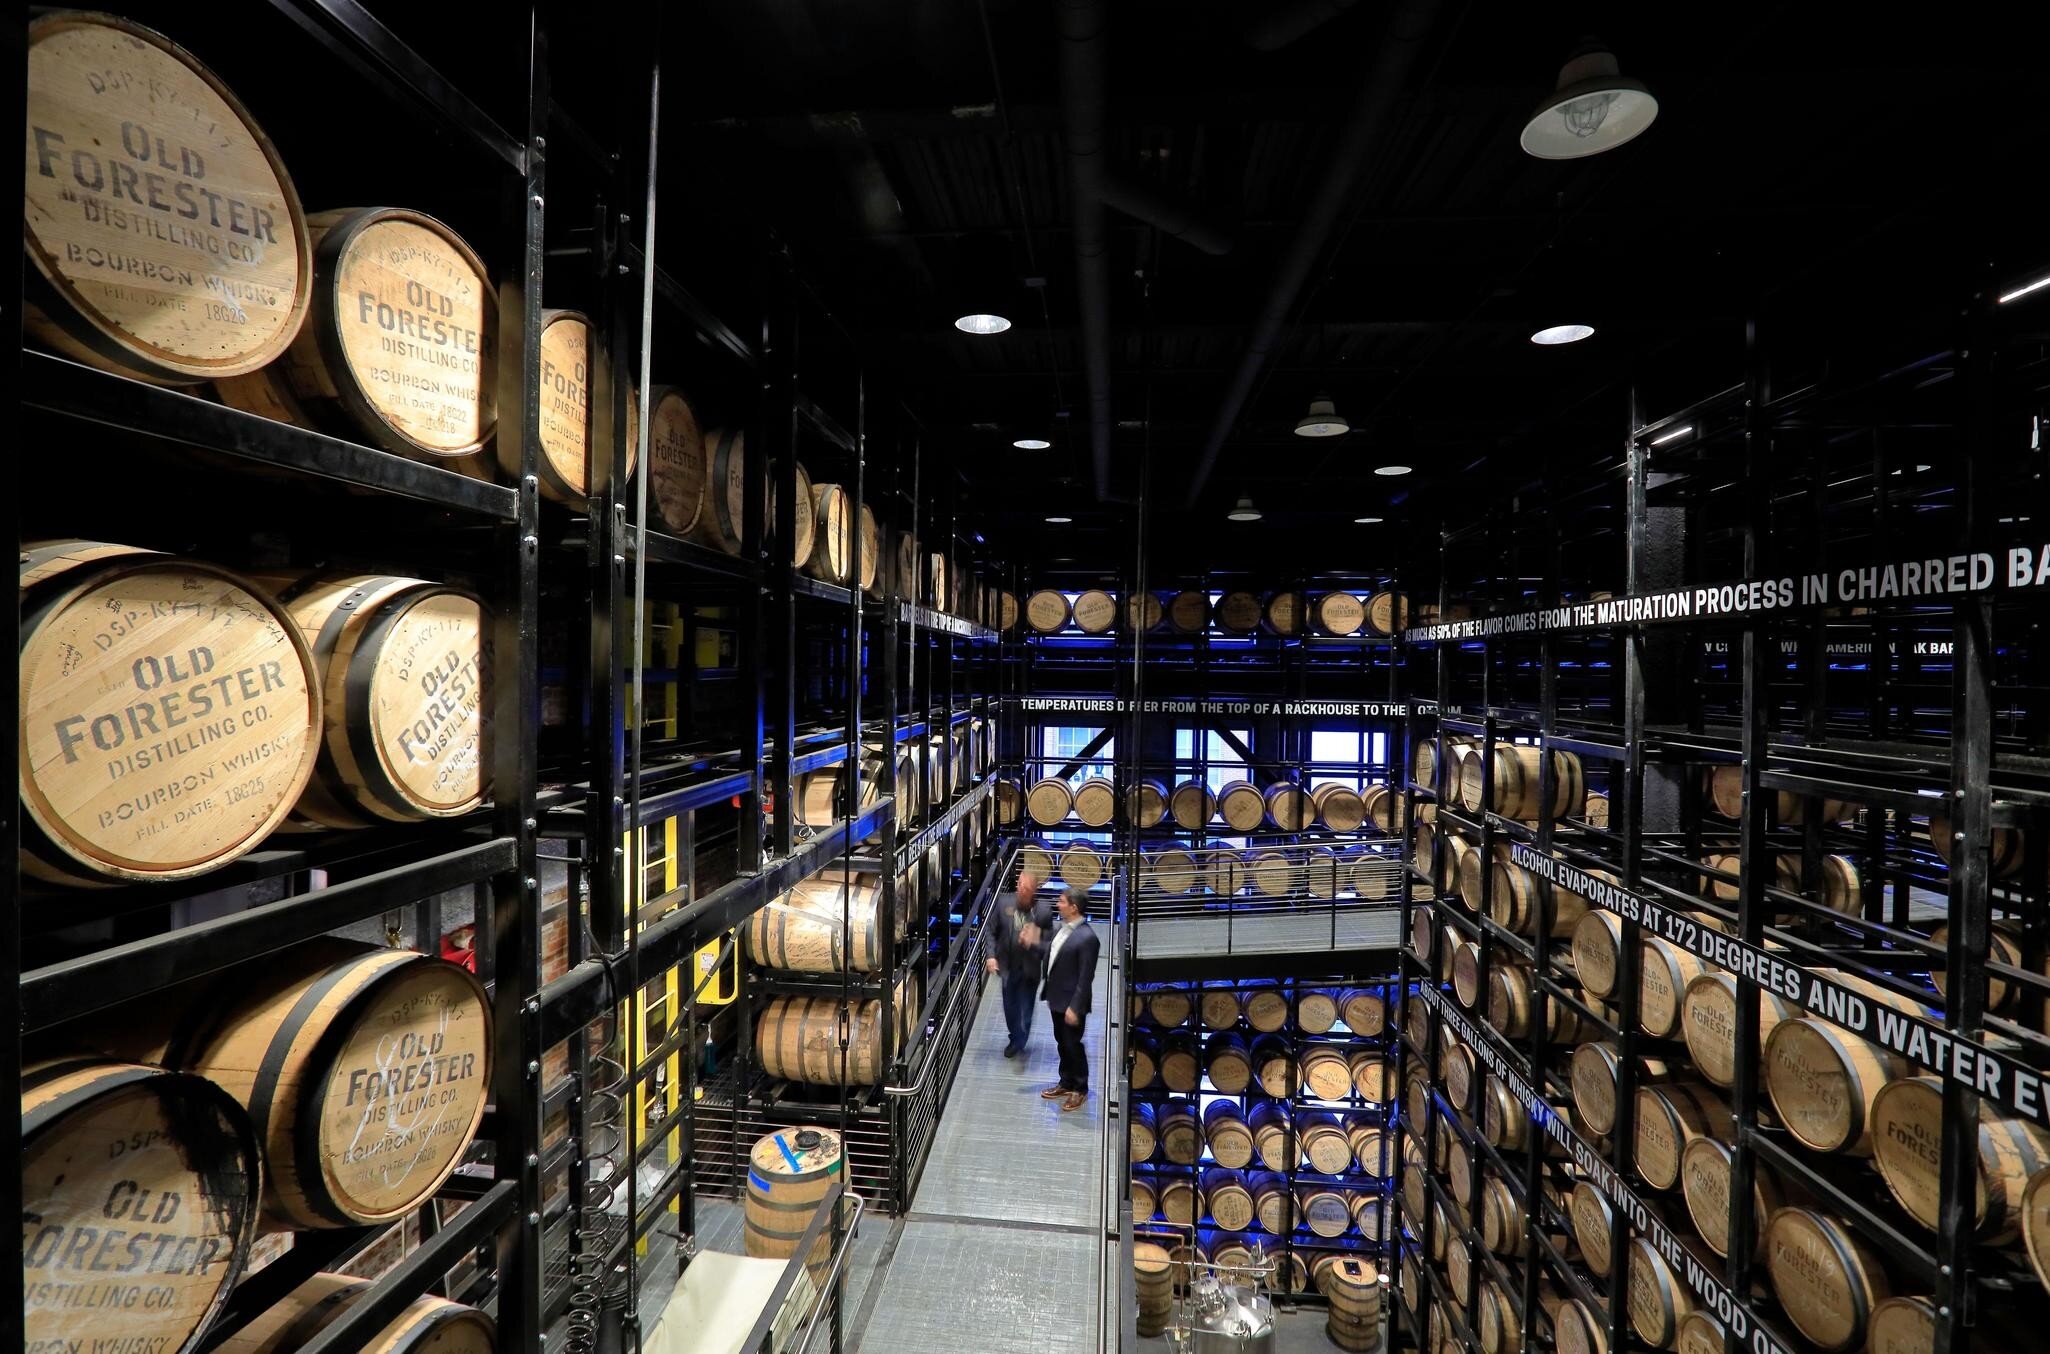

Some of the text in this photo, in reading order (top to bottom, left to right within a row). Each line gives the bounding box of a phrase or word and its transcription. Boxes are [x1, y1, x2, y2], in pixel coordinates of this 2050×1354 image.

[120, 121, 206, 180] OLD
[32, 126, 278, 244] FORESTER
[83, 199, 220, 254] DISTILLING
[66, 242, 193, 287] BOURBON
[406, 280, 454, 318] OLD
[381, 337, 458, 368] DISTILLING
[370, 367, 440, 392] BOURBON
[1412, 626, 1428, 642] MUCH
[1428, 625, 1437, 640] AS
[1437, 623, 1452, 639] 50%
[1452, 622, 1461, 638] OF
[1462, 621, 1475, 637] THE
[1475, 616, 1503, 637] FLAVOR
[1504, 612, 1536, 633] COMES
[1539, 607, 1571, 629] FROM
[1573, 603, 1595, 626] THE
[1597, 590, 1691, 624] MATURATION
[1695, 577, 1794, 615] PROCESS
[1802, 573, 1829, 606] IN
[1838, 552, 1994, 601] CHARRED
[131, 646, 215, 691] OLD
[421, 649, 460, 697] OLD
[53, 659, 286, 765] FORESTER
[1021, 698, 1114, 711] TEMPERATURES
[1117, 700, 1158, 712] DFFER
[1162, 701, 1196, 713] FROM
[1201, 702, 1223, 713] THE
[1227, 702, 1251, 714] TOP
[1254, 703, 1270, 714] OF
[1272, 703, 1281, 714] A
[1285, 703, 1360, 715] RACKHOUSE
[1363, 704, 1379, 716] TO
[1383, 704, 1406, 716] THE
[108, 704, 273, 780] DISTILLING CO.
[98, 764, 215, 829] BOURBON
[136, 820, 169, 841] FILL
[225, 776, 265, 806] 18G25
[1511, 844, 1556, 881] ALCOHOL
[1559, 865, 1639, 921] EVAPORATES
[1642, 903, 1662, 932] AT
[1665, 914, 1697, 951] 172
[1701, 929, 1801, 1000] DEGREES
[1808, 979, 1867, 1031] AND
[1876, 1007, 2002, 1100] WATER
[1707, 1005, 1725, 1022] OLD
[399, 1032, 443, 1061] OLD
[346, 1053, 475, 1107] FORESTER
[363, 1093, 437, 1126] DISTILLING
[342, 1132, 414, 1166] BOURBON
[1420, 981, 1441, 1010] ABOUT
[1440, 1000, 1461, 1033] THREE
[1461, 1022, 1495, 1068] GALLONS
[1495, 1060, 1507, 1081] OF
[1508, 1070, 1544, 1123] WHISKY
[1545, 1111, 1573, 1154] WILL
[1575, 1142, 1610, 1194] SOAK
[1613, 1178, 1648, 1232] INTO
[1651, 1219, 1683, 1273] THE
[1686, 1256, 1747, 1340] WOOD
[103, 1180, 181, 1224] OLD
[1777, 1240, 1840, 1304] FORESTER
[144, 1287, 175, 1308] CO.
